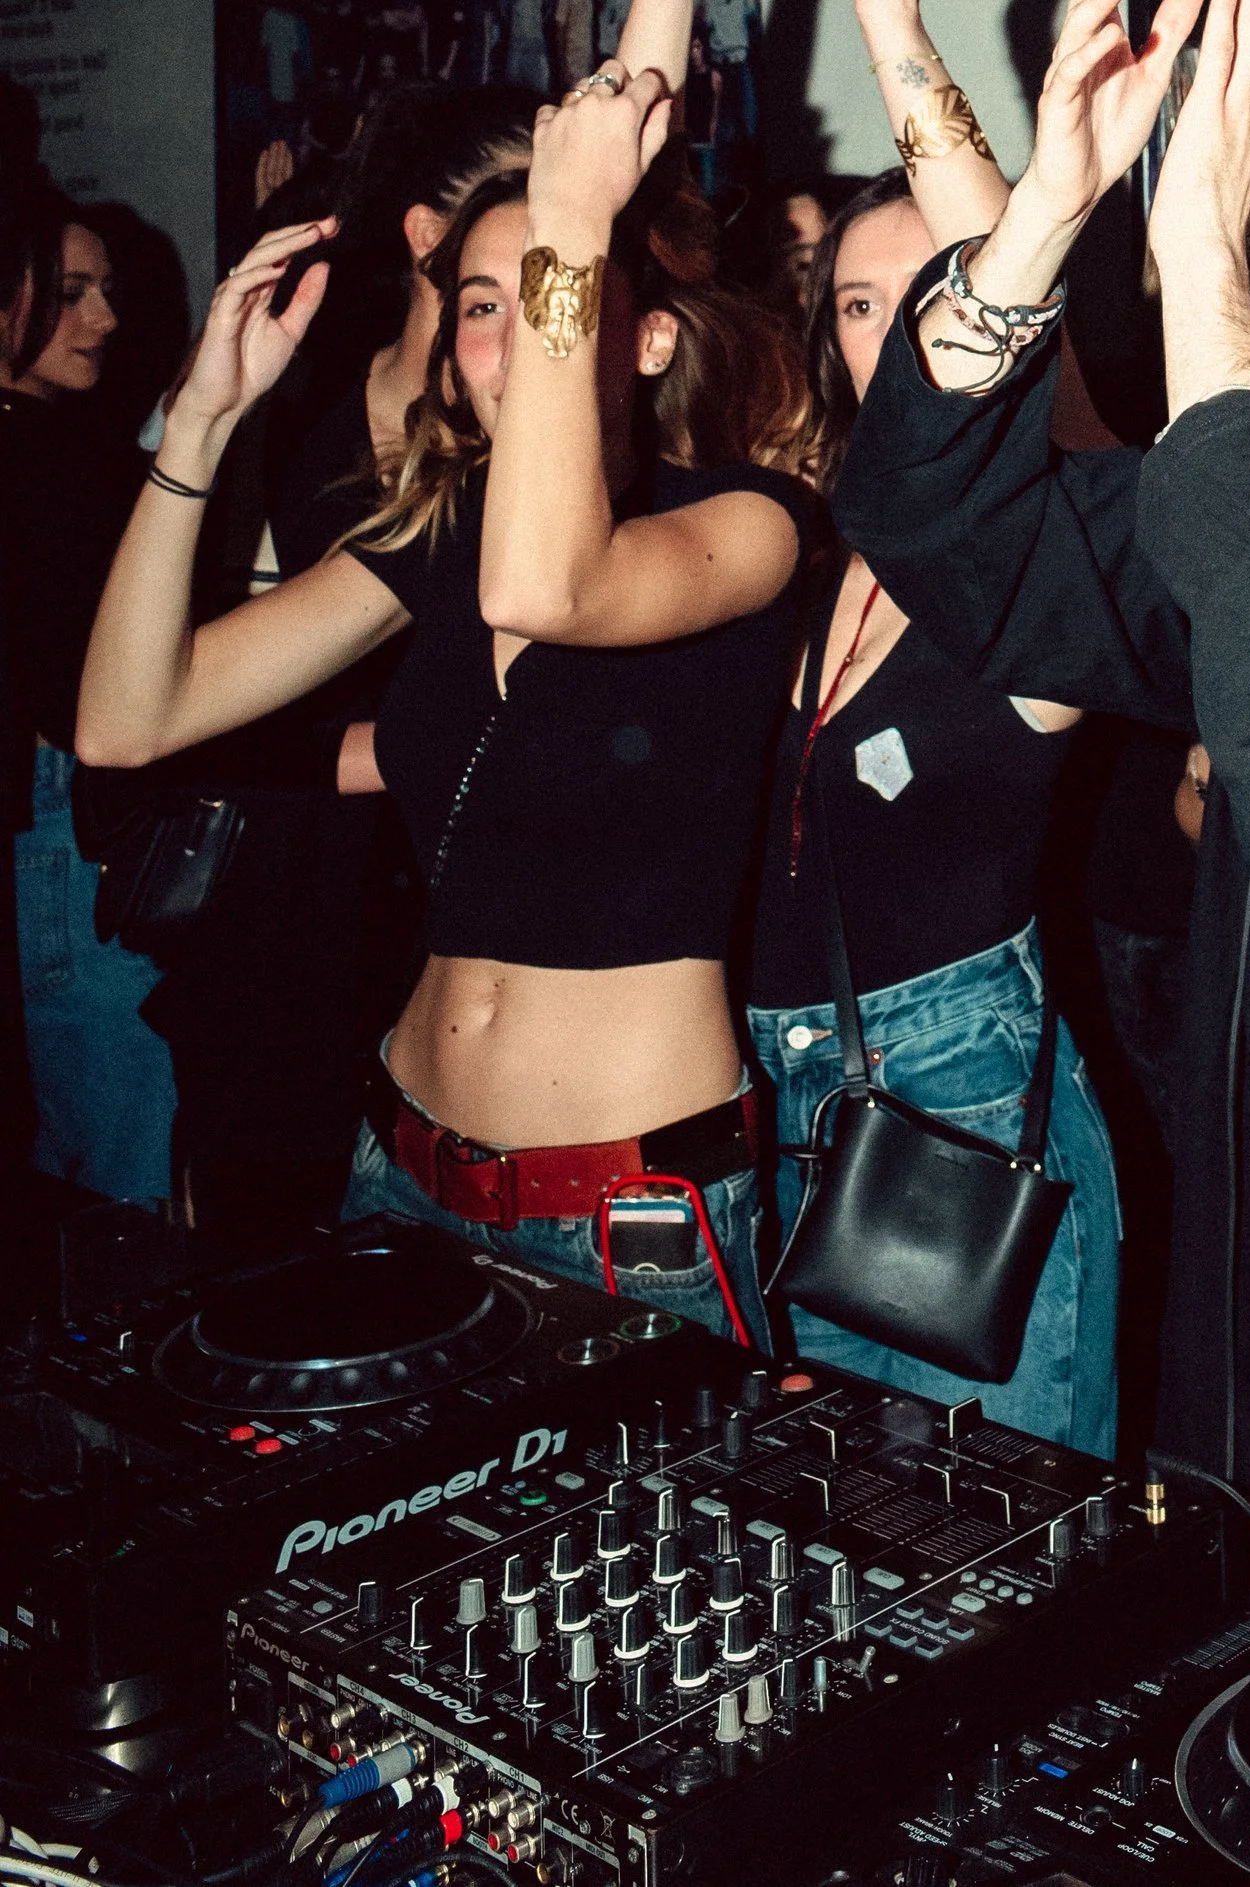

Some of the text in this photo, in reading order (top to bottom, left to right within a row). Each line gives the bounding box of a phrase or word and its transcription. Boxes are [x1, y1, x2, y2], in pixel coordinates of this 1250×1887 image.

[275, 1457, 500, 1575] Pioneer
[240, 1623, 310, 1673] Pioneer
[388, 1673, 491, 1724] Pioneer
[401, 1709, 417, 1725] CH3
[453, 1737, 470, 1753] CH2
[509, 1767, 526, 1782] CH1
[1033, 1805, 1065, 1822] MEMORY
